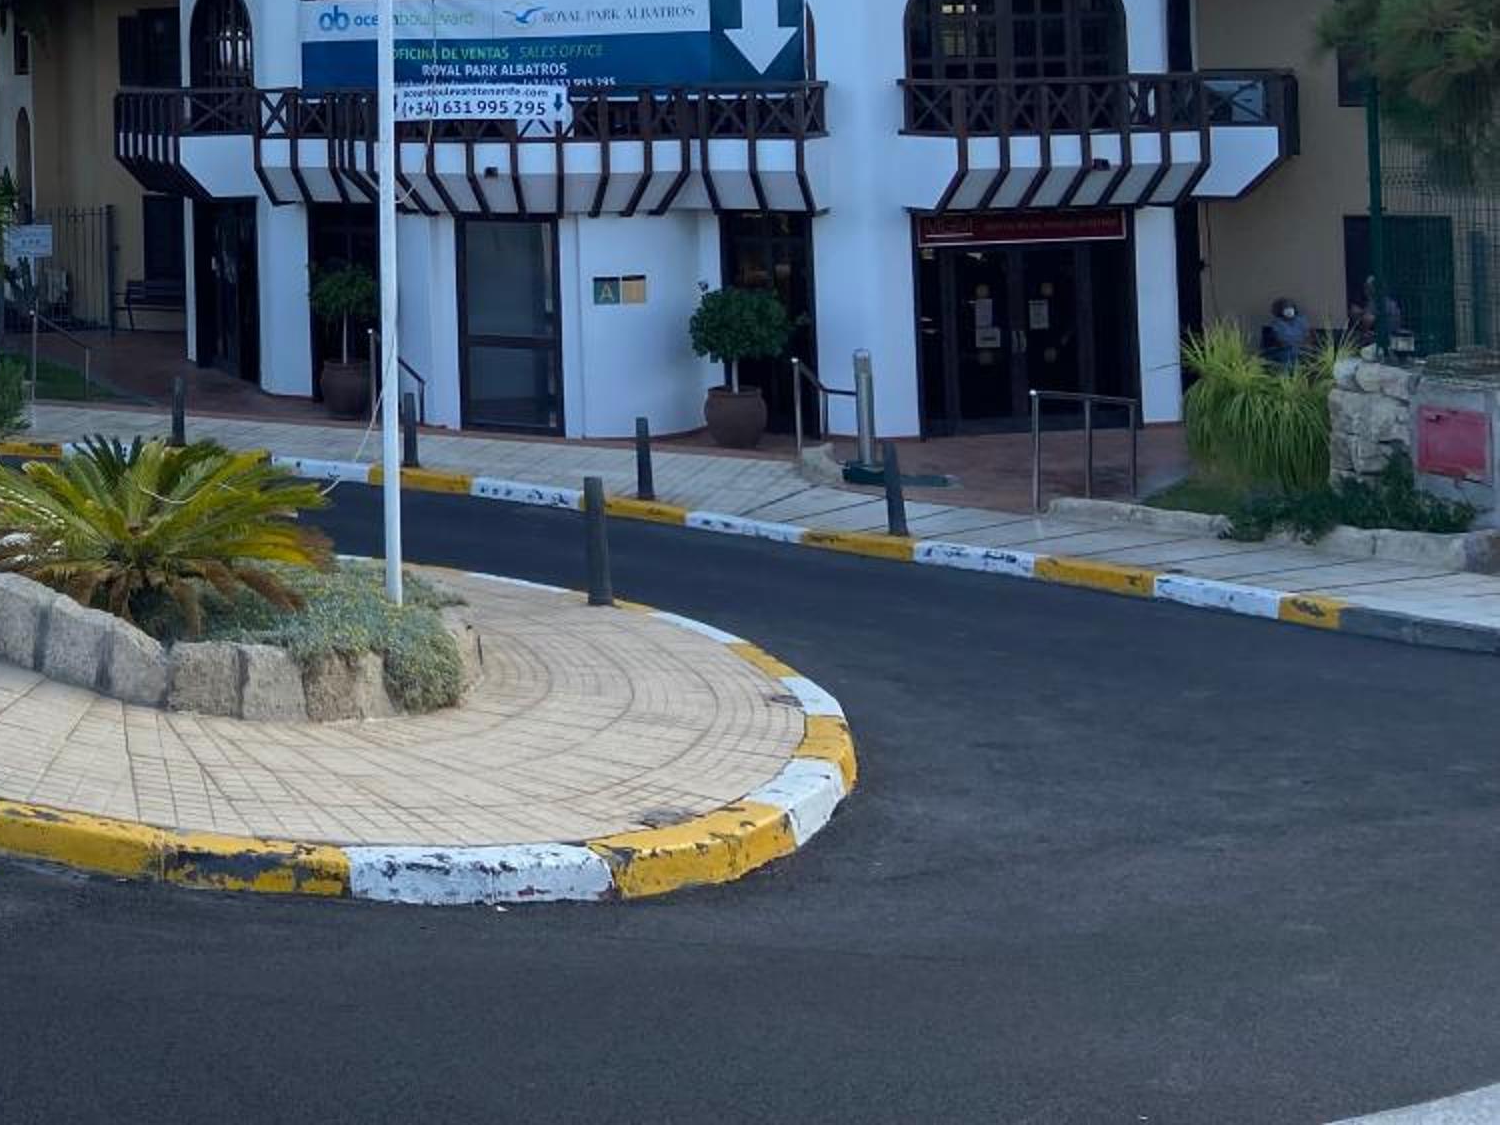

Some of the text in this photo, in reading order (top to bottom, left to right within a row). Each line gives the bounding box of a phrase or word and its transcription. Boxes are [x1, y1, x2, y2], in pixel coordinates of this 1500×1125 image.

[353, 11, 474, 26] ocenboulevard
[542, 5, 695, 23] ROYAL PARK ALBATROS
[442, 47, 458, 60] DE
[461, 46, 509, 59] VENTAS
[421, 62, 568, 76] ROYAL PARK ALBATROS
[403, 100, 546, 117] (+34) 631 995 295
